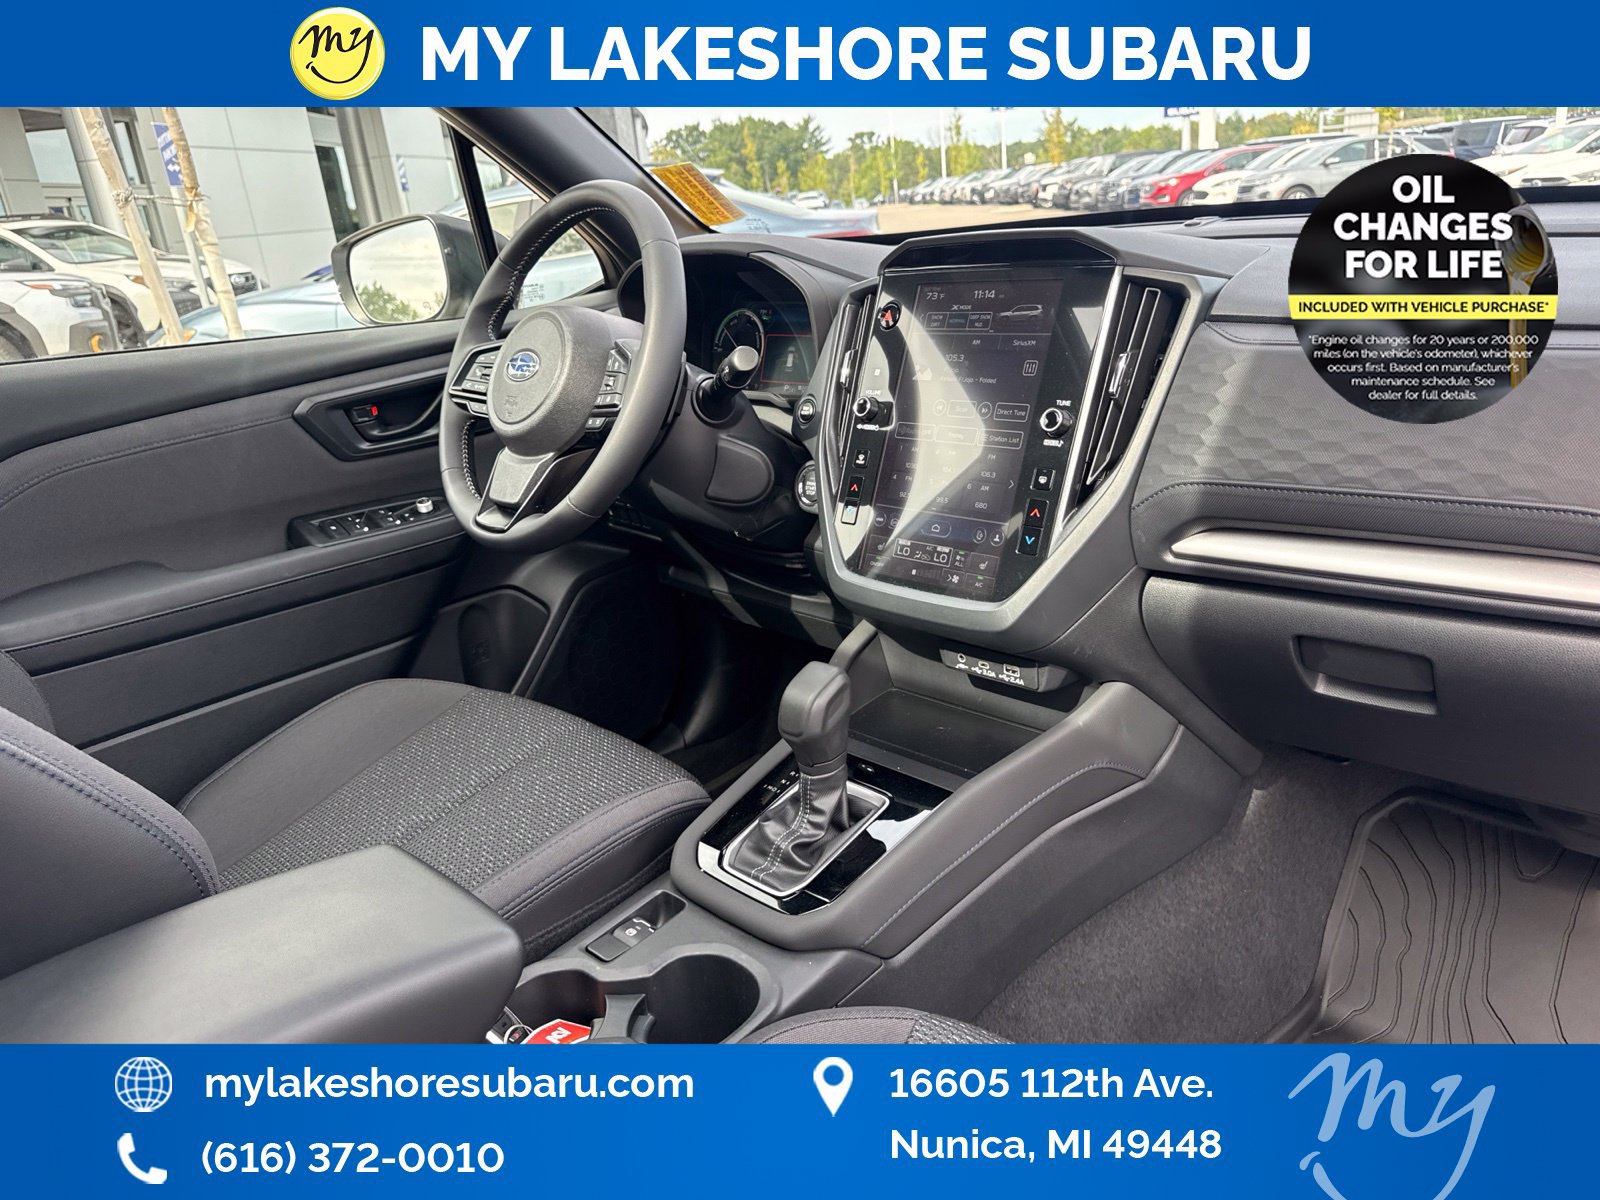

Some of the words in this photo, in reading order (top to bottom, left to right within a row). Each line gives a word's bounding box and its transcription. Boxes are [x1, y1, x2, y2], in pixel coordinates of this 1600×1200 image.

[973, 289, 996, 299] 11:14
[1012, 339, 1037, 347] SiriusXM
[1056, 399, 1072, 407] TUNE
[996, 408, 1012, 416] Direct
[1014, 409, 1027, 417] Tune
[988, 435, 1007, 443] Station
[1008, 436, 1020, 444] List
[896, 546, 911, 556] LO
[933, 553, 948, 563] LO
